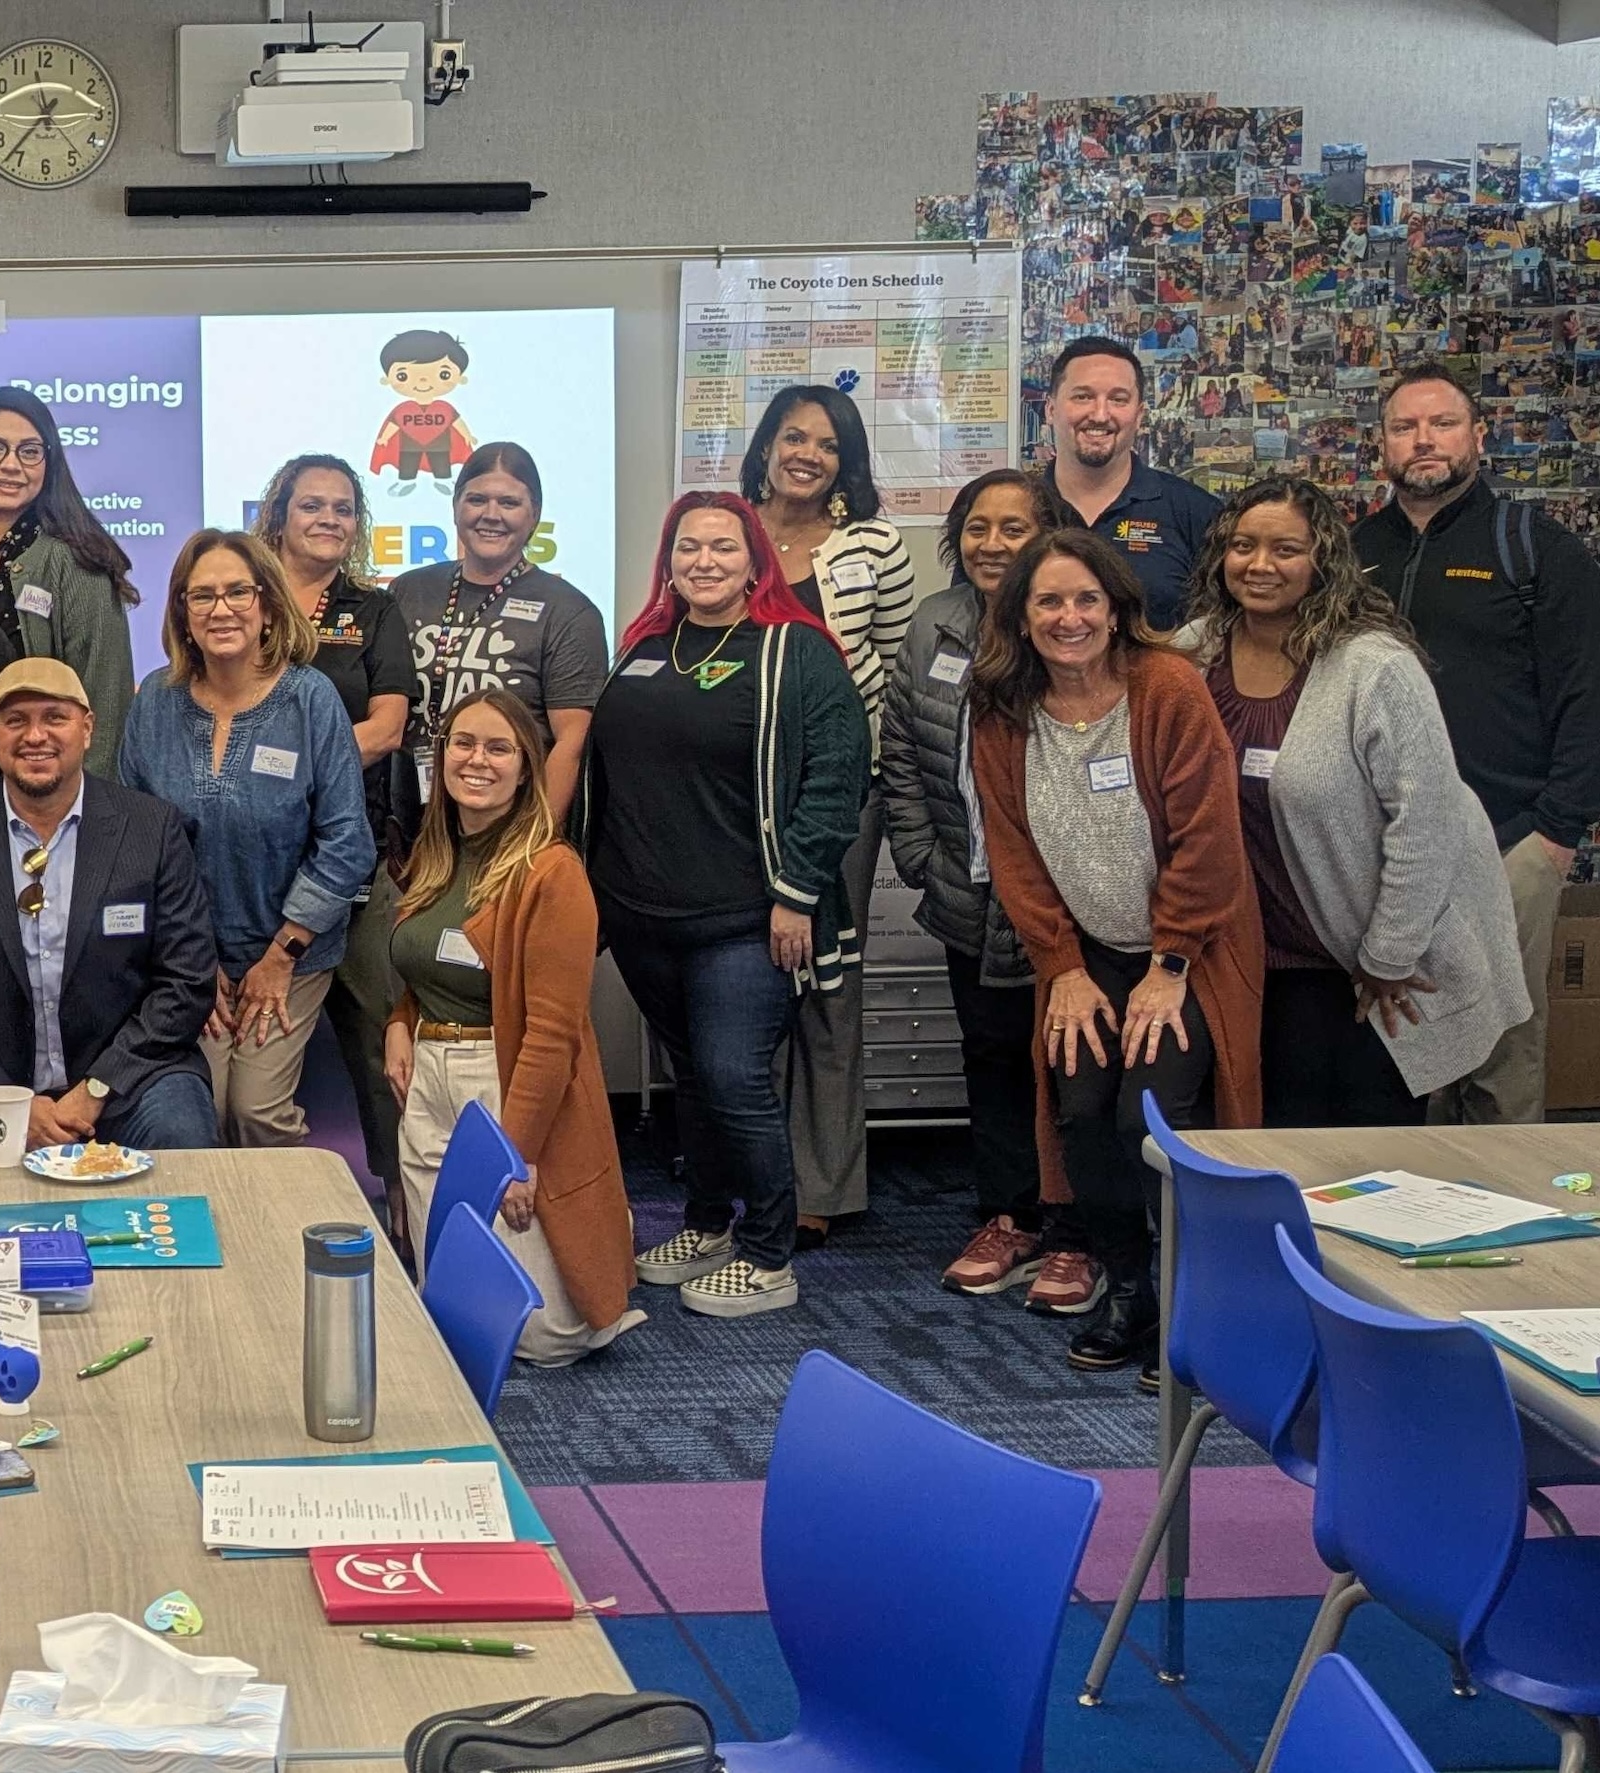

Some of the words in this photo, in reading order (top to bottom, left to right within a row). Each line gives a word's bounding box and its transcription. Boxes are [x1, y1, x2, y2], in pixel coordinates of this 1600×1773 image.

[13, 58, 25, 76] 11
[38, 51, 53, 68] 12
[70, 58, 74, 76] 1
[87, 78, 96, 95] 2
[94, 107, 103, 121] 3
[87, 132, 96, 148] 4
[15, 151, 25, 167] 7
[41, 159, 51, 175] 6
[68, 151, 77, 167] 5
[747, 278, 777, 290] The
[780, 276, 834, 292] Coyote
[838, 276, 868, 289] Den
[872, 274, 943, 288] Schedule
[827, 303, 861, 311] Wednesday
[403, 414, 445, 426] PESD
[1129, 521, 1157, 529] PSUSD
[1456, 569, 1493, 580] RIVERSIDE
[421, 624, 498, 669] SEL
